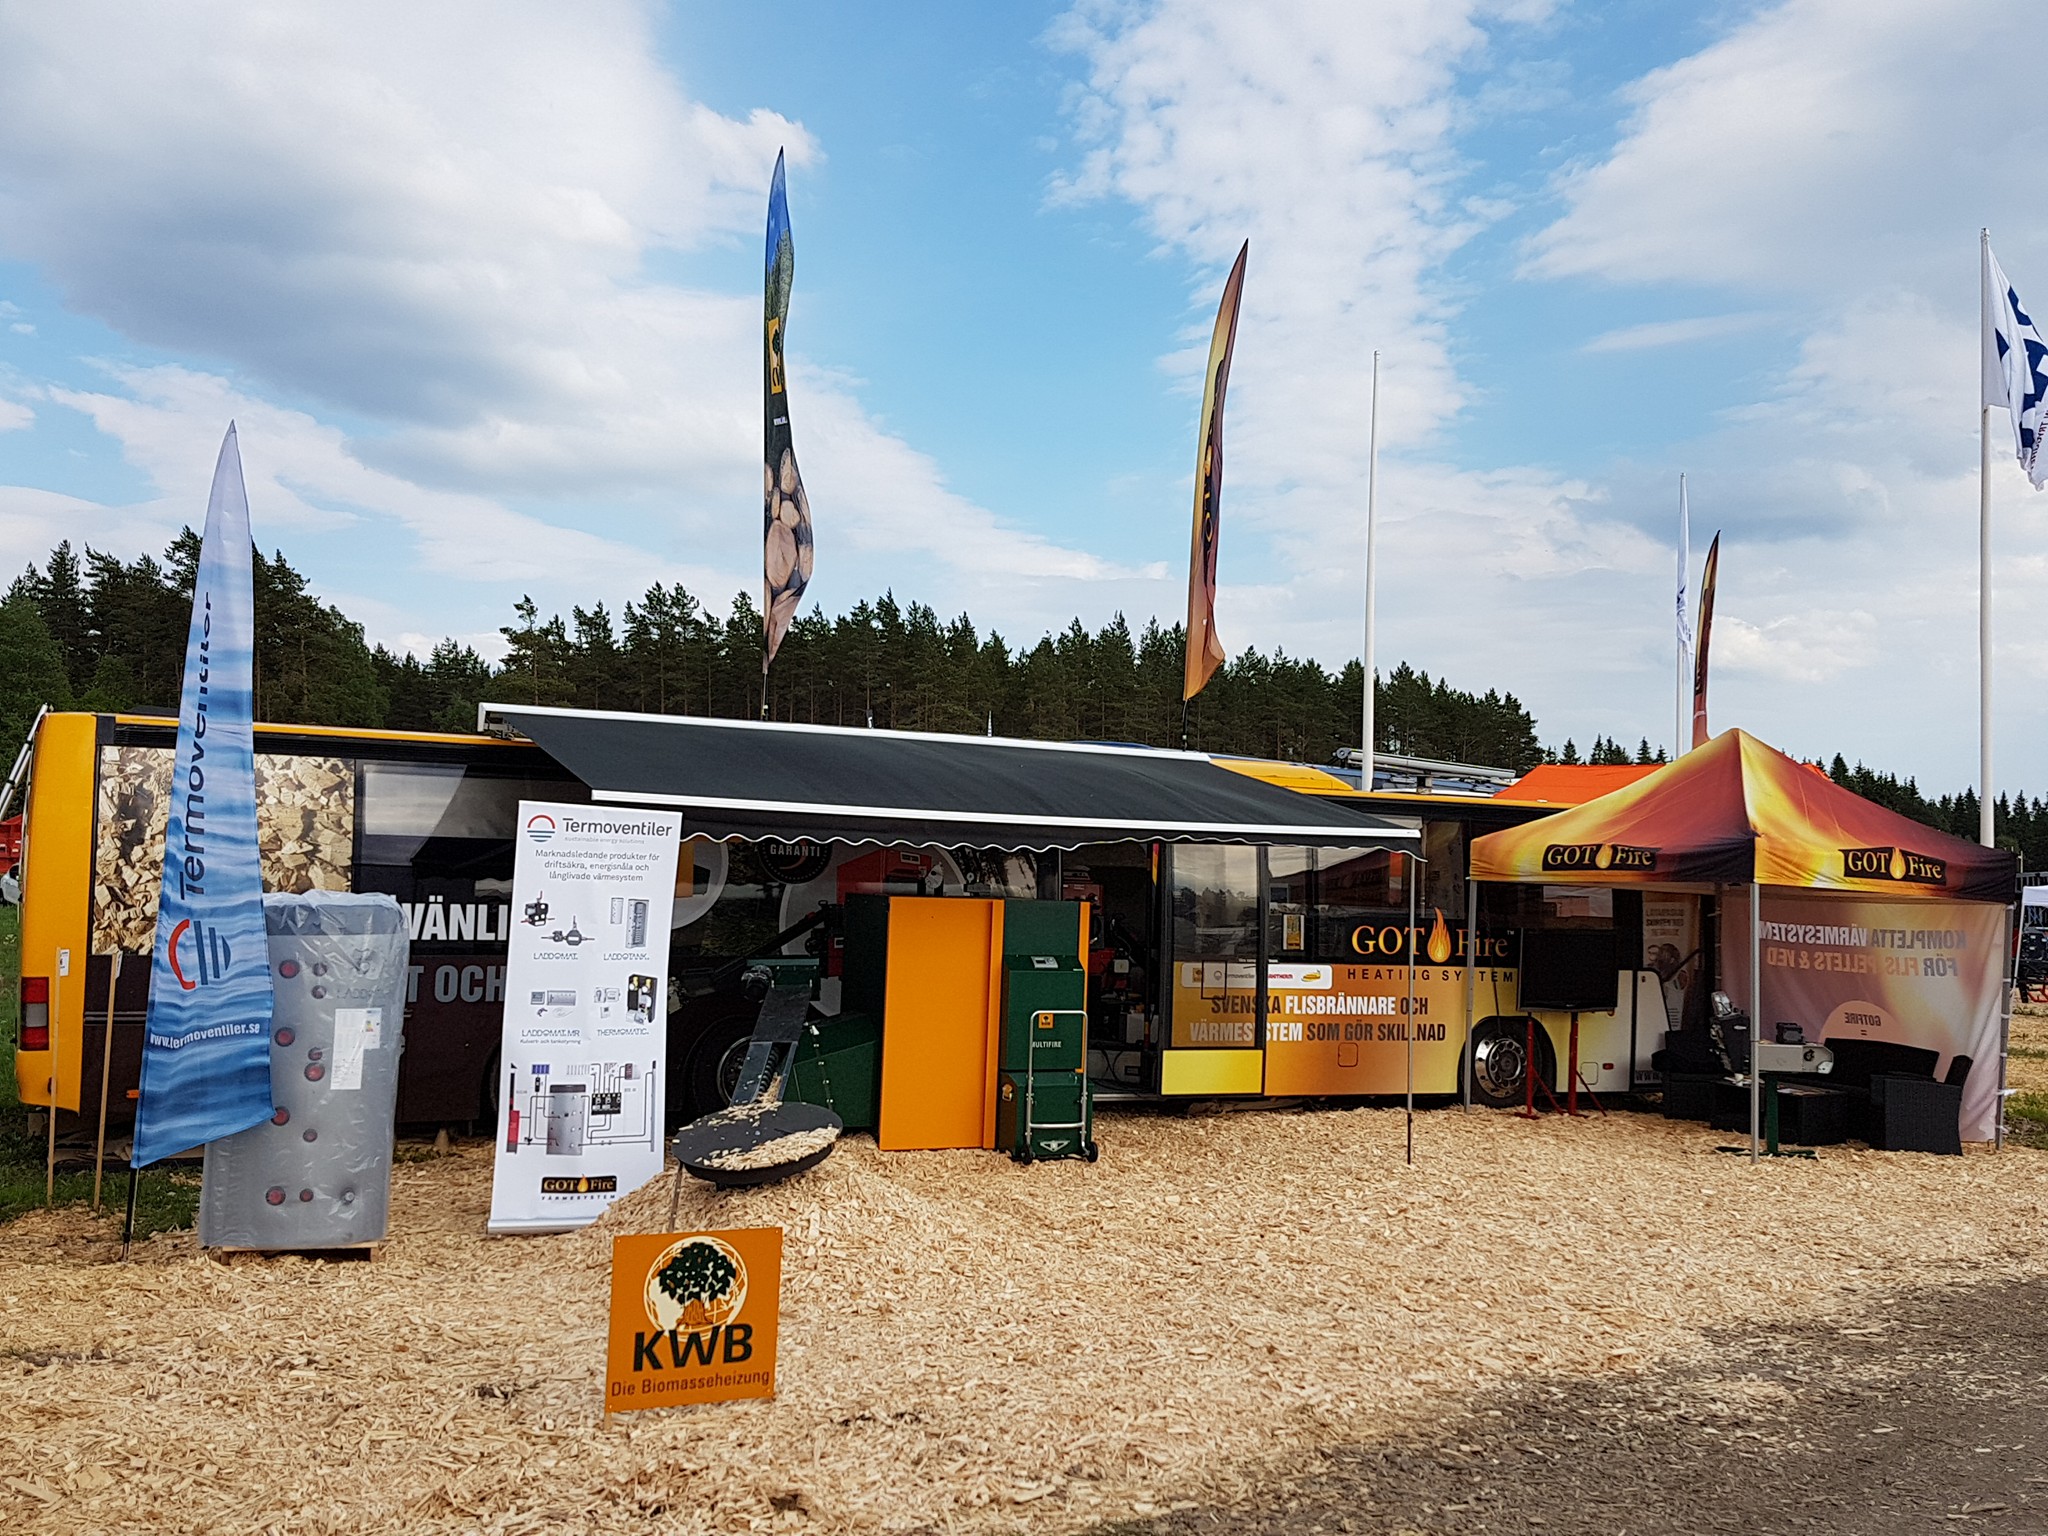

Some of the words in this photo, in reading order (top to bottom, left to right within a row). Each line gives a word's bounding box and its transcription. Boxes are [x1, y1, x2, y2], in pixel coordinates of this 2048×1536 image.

[180, 591, 212, 901] Termoventiler
[562, 817, 673, 837] Termoventiler
[535, 849, 608, 860] Marknadsledande
[609, 852, 647, 862] produkter
[648, 853, 660, 861] för
[770, 844, 820, 857] GARANTI
[1547, 846, 1596, 865] GOT
[1613, 847, 1653, 866] Fire
[544, 860, 588, 870] driftsäkra,
[589, 862, 633, 872] energisnåla
[635, 863, 650, 871] och
[1848, 851, 1889, 873] GOT
[1907, 856, 1943, 879] Fire
[549, 871, 591, 882] långlivade
[592, 873, 643, 883] värmesystem
[1351, 925, 1426, 956] GOT
[1456, 928, 1509, 957] Fire
[434, 965, 507, 1003] OCH
[1347, 968, 1430, 981] HEATIG
[1442, 970, 1514, 982] SYTEM
[1285, 992, 1396, 1015] FLISBRÄNNARE
[1400, 996, 1428, 1015] OCH
[1189, 1018, 1303, 1042] VÄRMESSTEM
[1307, 1022, 1340, 1042] SOM
[1344, 1019, 1374, 1042] GÖR
[543, 1178, 578, 1191] GOT
[590, 1178, 614, 1190] Fire
[633, 1323, 753, 1372] KWB
[611, 1380, 636, 1397] Die
[641, 1370, 771, 1395] Biomasseheizung
